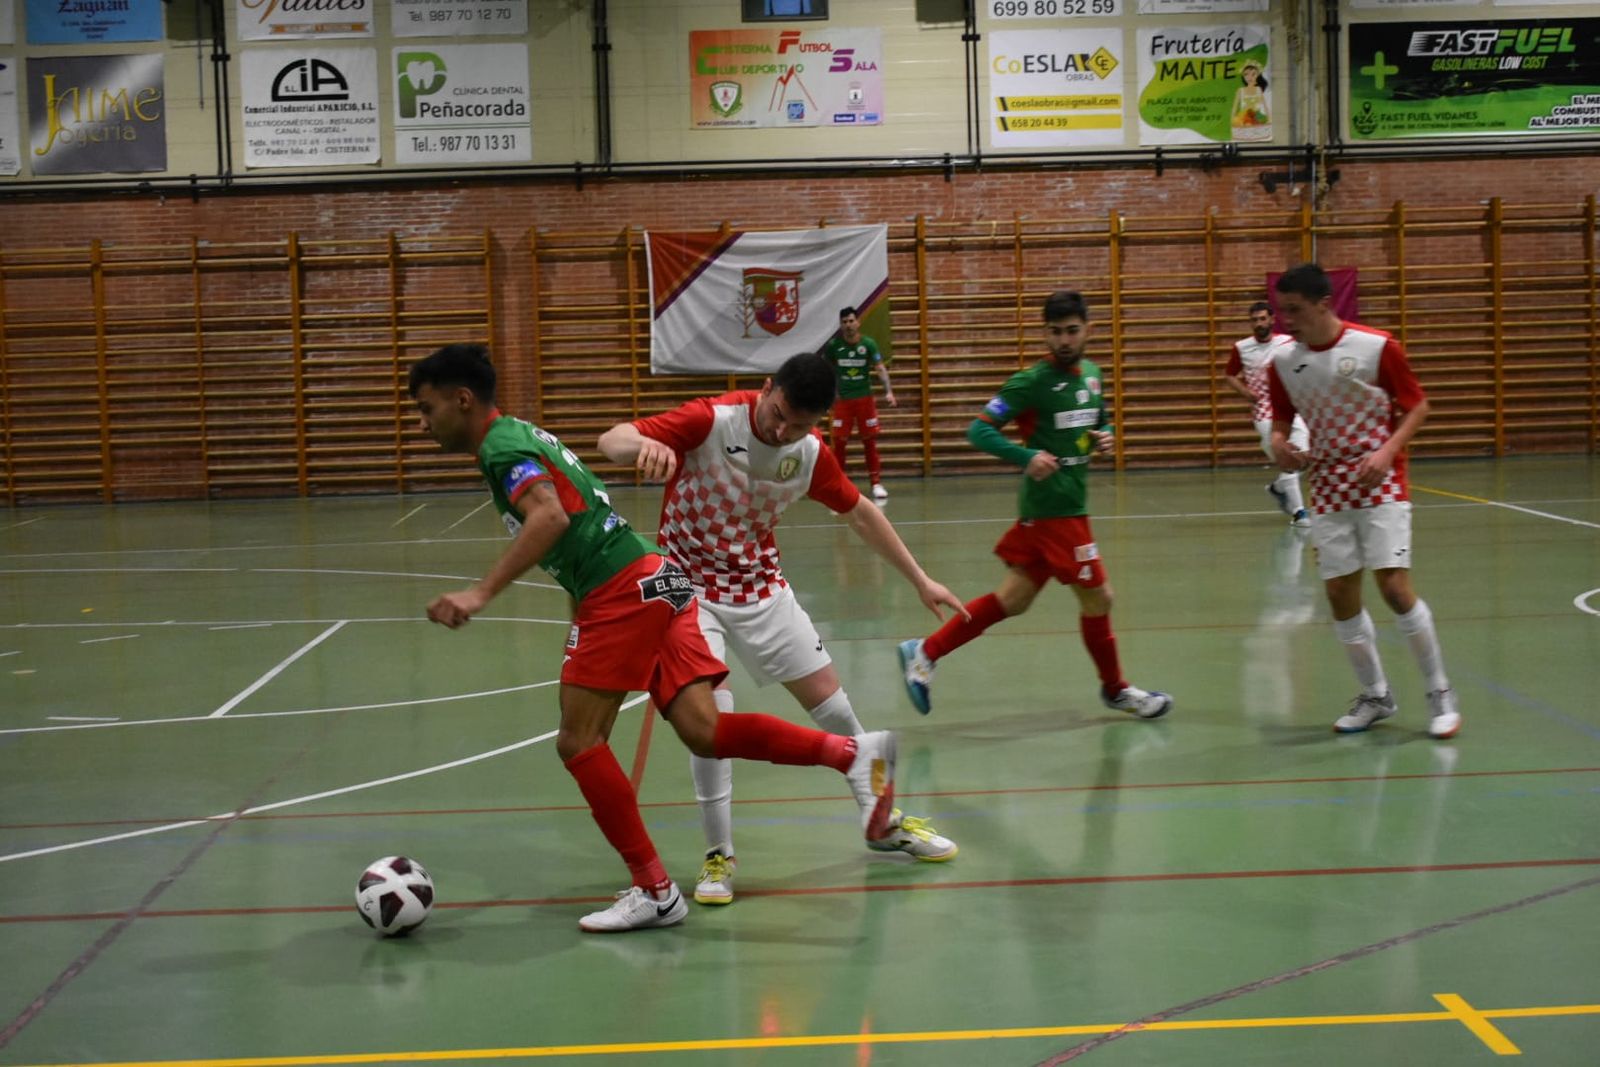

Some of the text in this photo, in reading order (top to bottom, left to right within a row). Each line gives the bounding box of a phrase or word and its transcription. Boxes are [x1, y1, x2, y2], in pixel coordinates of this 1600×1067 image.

[429, 10, 452, 21] 987
[457, 9, 473, 20] 70
[478, 9, 492, 20] 12
[496, 8, 512, 19] 70
[993, 0, 1114, 16] 699 80 52 59
[777, 31, 833, 54] FUTBOL
[1151, 31, 1245, 56] Frutería
[829, 49, 877, 72] SALA
[1159, 60, 1237, 81] MAITE
[491, 86, 524, 95] DENTAL
[420, 99, 525, 118] Peñacorada
[1530, 118, 1543, 126] AL
[1546, 117, 1579, 126] MEJOR
[439, 136, 462, 151] 987
[466, 136, 481, 150] 70
[485, 135, 499, 150] 13
[502, 134, 516, 149] 31
